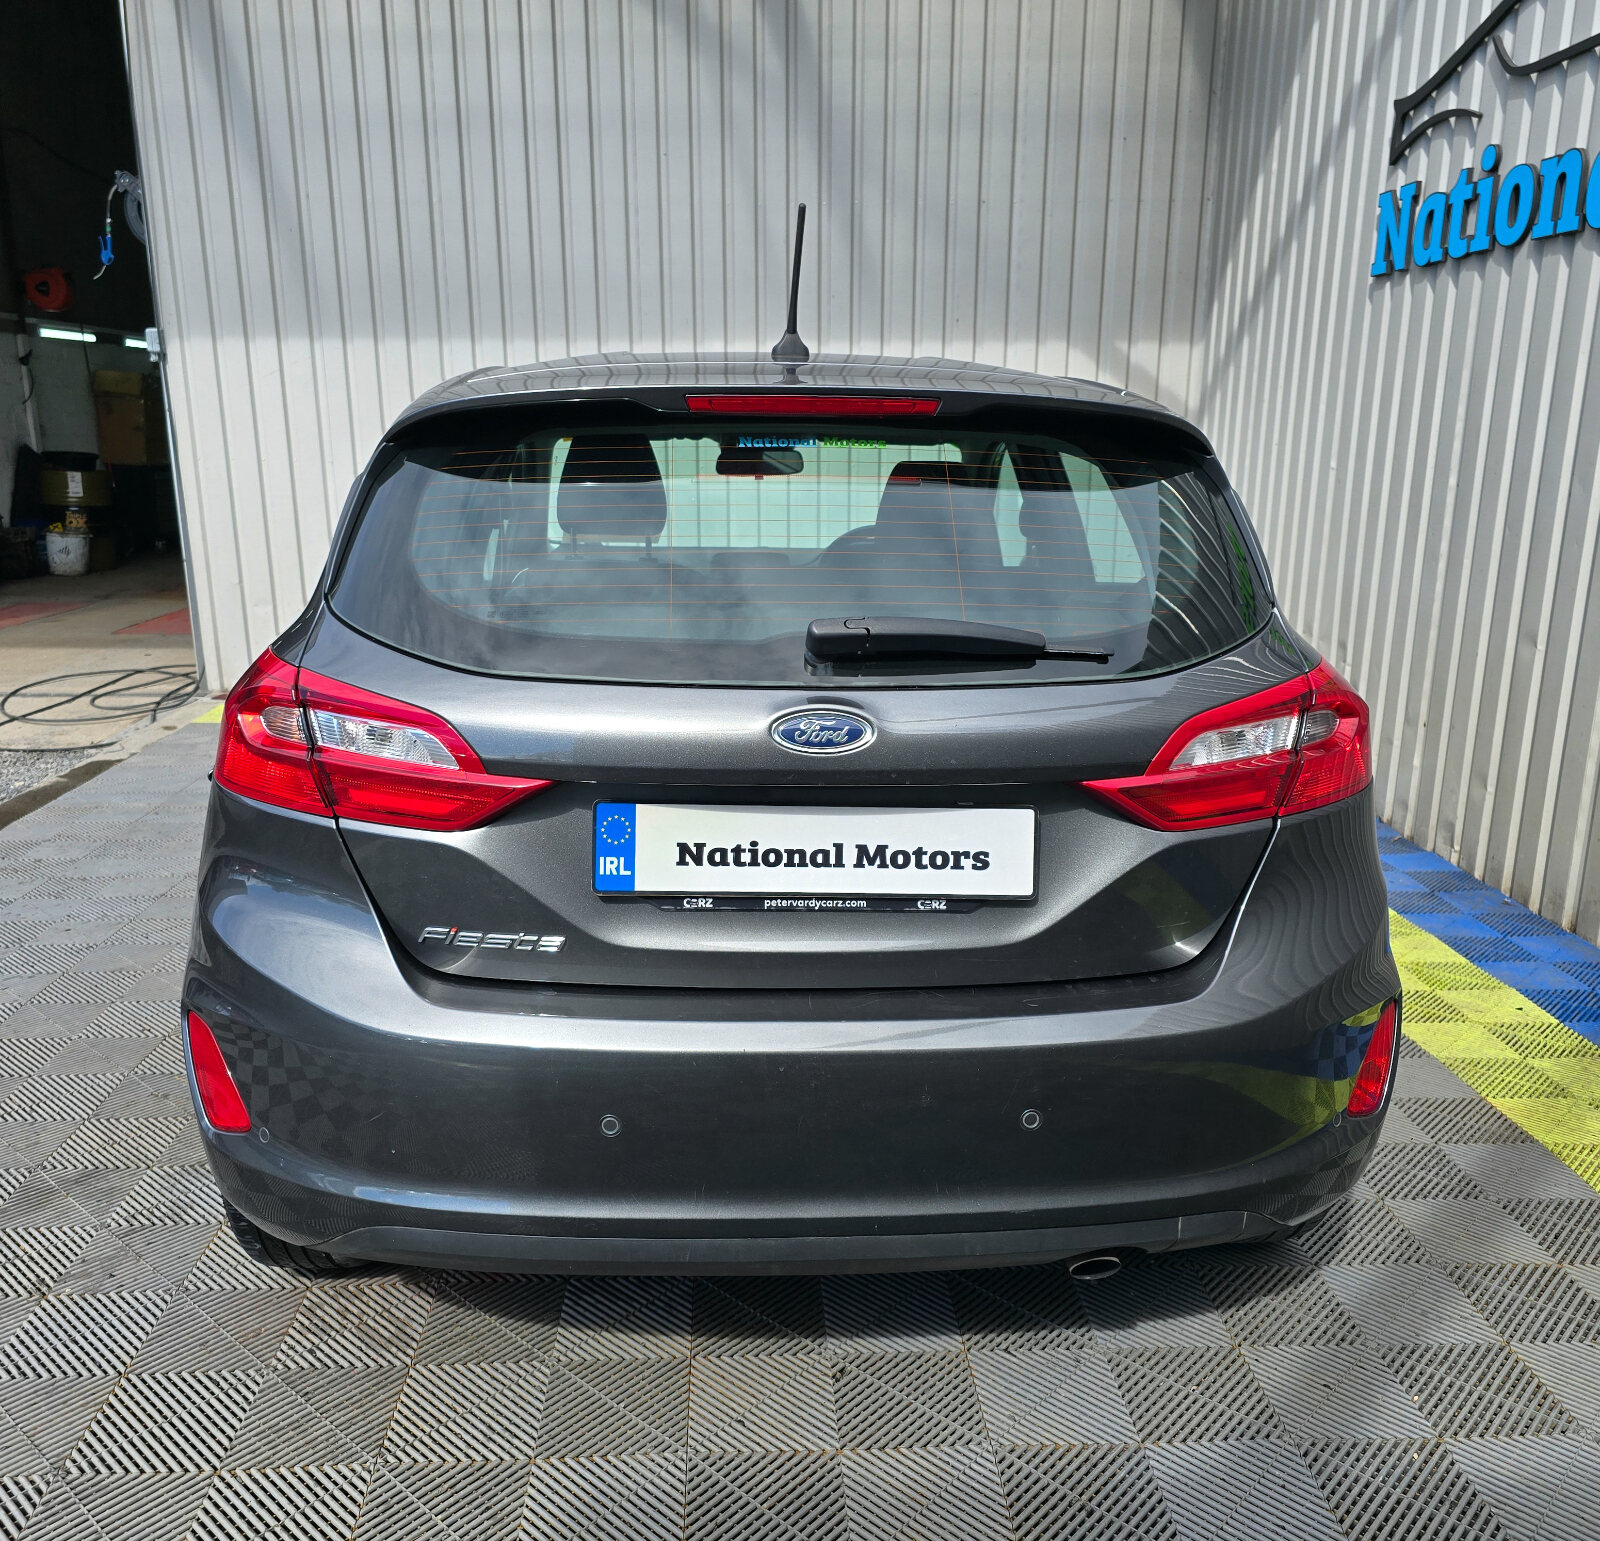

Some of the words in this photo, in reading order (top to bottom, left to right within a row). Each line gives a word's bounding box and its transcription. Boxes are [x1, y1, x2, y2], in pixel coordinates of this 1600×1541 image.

[738, 436, 817, 448] National
[823, 437, 887, 449] Motors
[794, 719, 850, 743] Ford
[599, 856, 632, 876] IRL
[676, 840, 845, 869] National
[853, 844, 990, 871] Motors
[764, 898, 867, 910] petervardycarz.com
[417, 926, 567, 952] Fiesta
